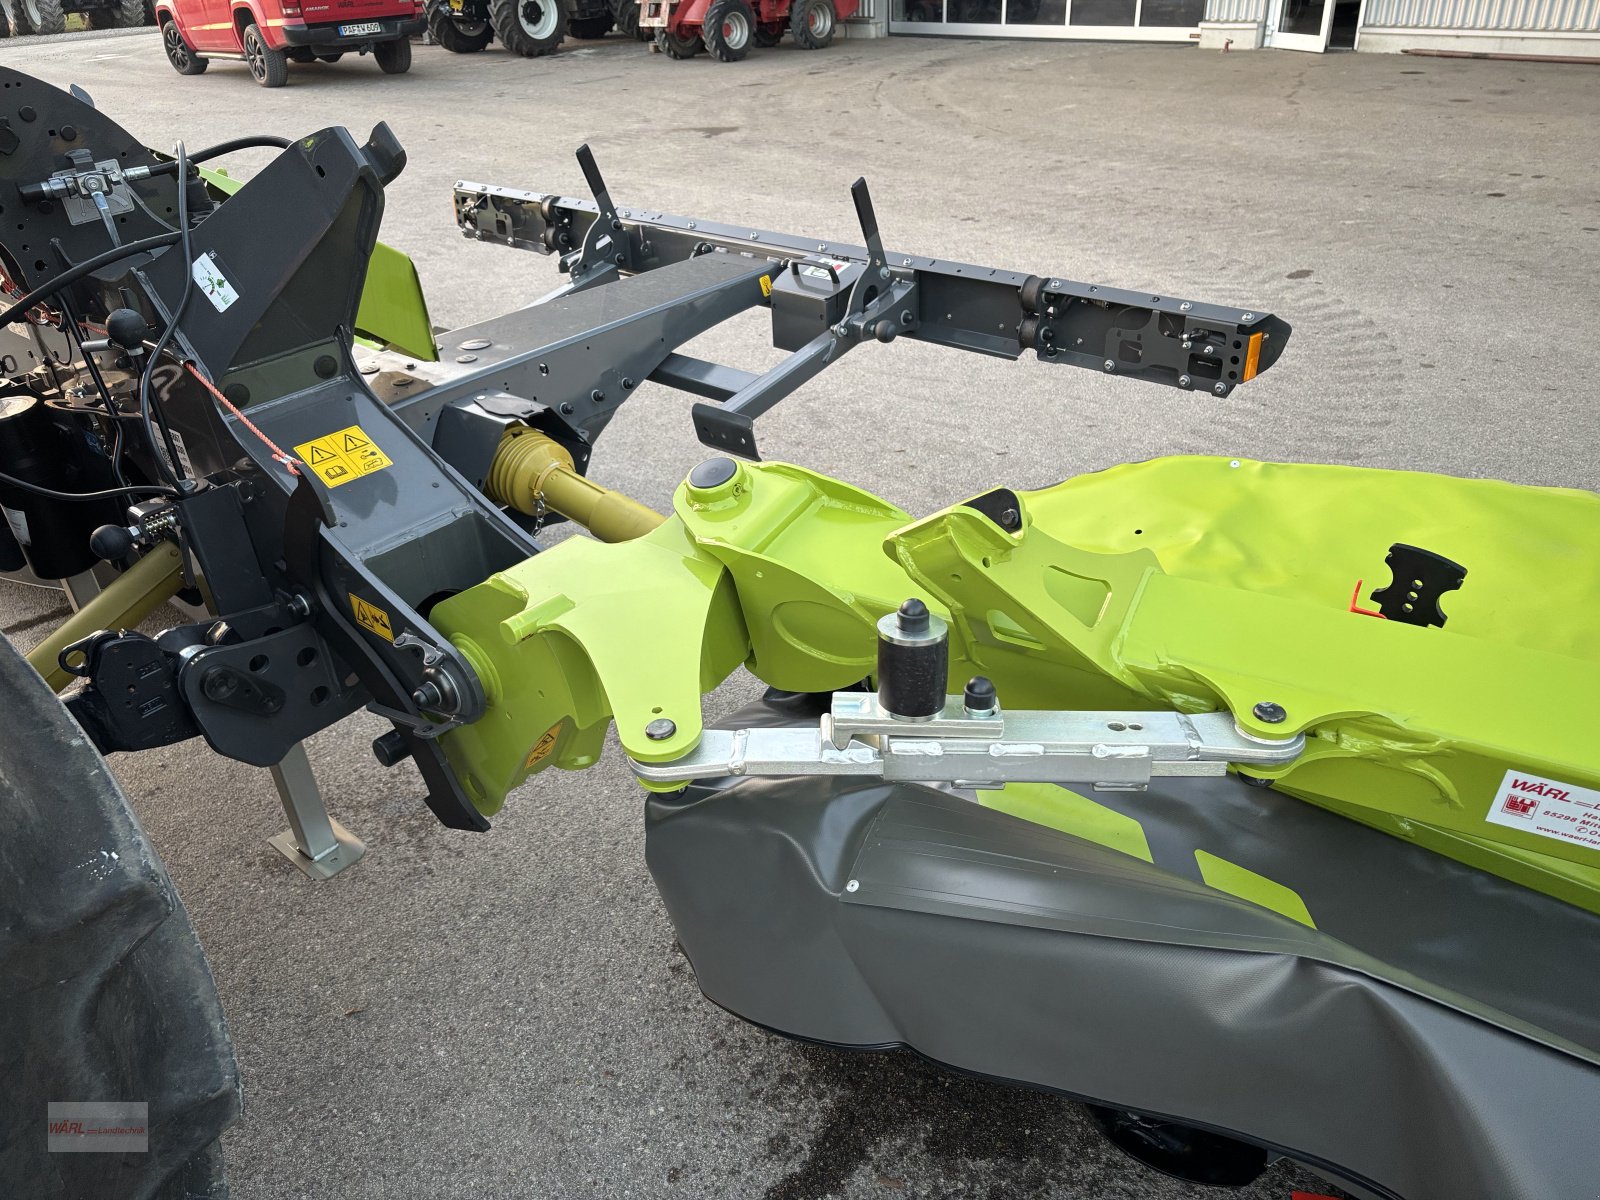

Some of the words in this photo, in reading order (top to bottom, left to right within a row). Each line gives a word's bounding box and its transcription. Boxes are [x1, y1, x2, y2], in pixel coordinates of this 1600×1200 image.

[343, 26, 357, 34] PAF
[366, 23, 379, 32] 609
[1511, 778, 1571, 803] WÄRL
[1542, 810, 1578, 823] 85298
[1583, 812, 1600, 821] Ha
